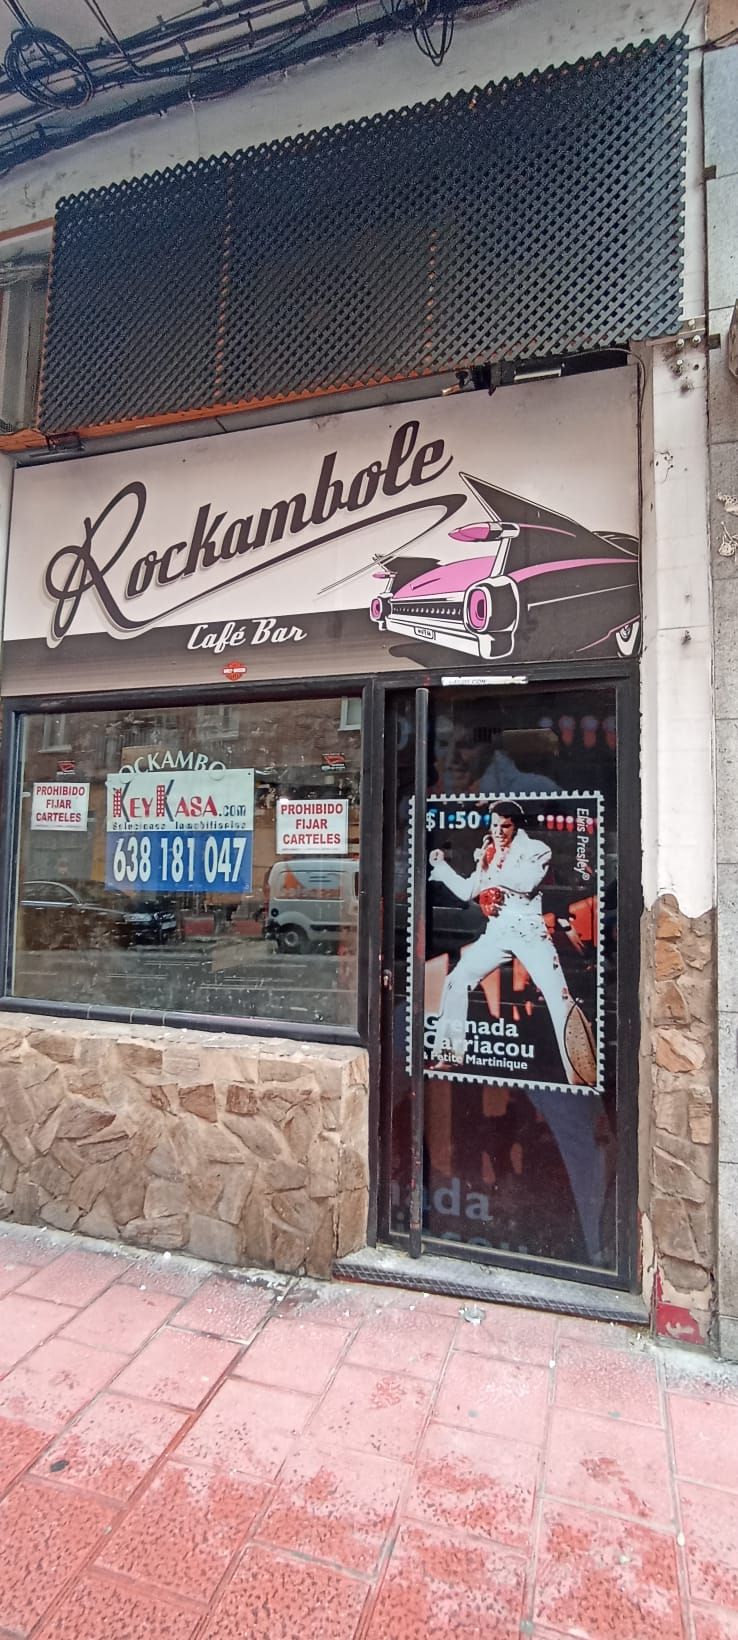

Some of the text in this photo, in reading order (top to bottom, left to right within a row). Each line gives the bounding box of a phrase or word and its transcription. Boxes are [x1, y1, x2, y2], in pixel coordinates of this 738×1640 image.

[45, 420, 454, 639] Rockambole
[187, 618, 308, 653] Café Bar
[36, 785, 86, 796] PROHIBIDO
[46, 799, 72, 809] FIJAR
[280, 803, 344, 815] PROHIBIDO
[36, 812, 82, 823] CARTELES
[295, 818, 328, 830] FIJAR
[425, 809, 482, 832] $1.50
[576, 807, 590, 833] Elvis
[282, 833, 342, 845] CARTELES
[113, 836, 247, 884] 638 181 047
[465, 1054, 529, 1072] Martinique
